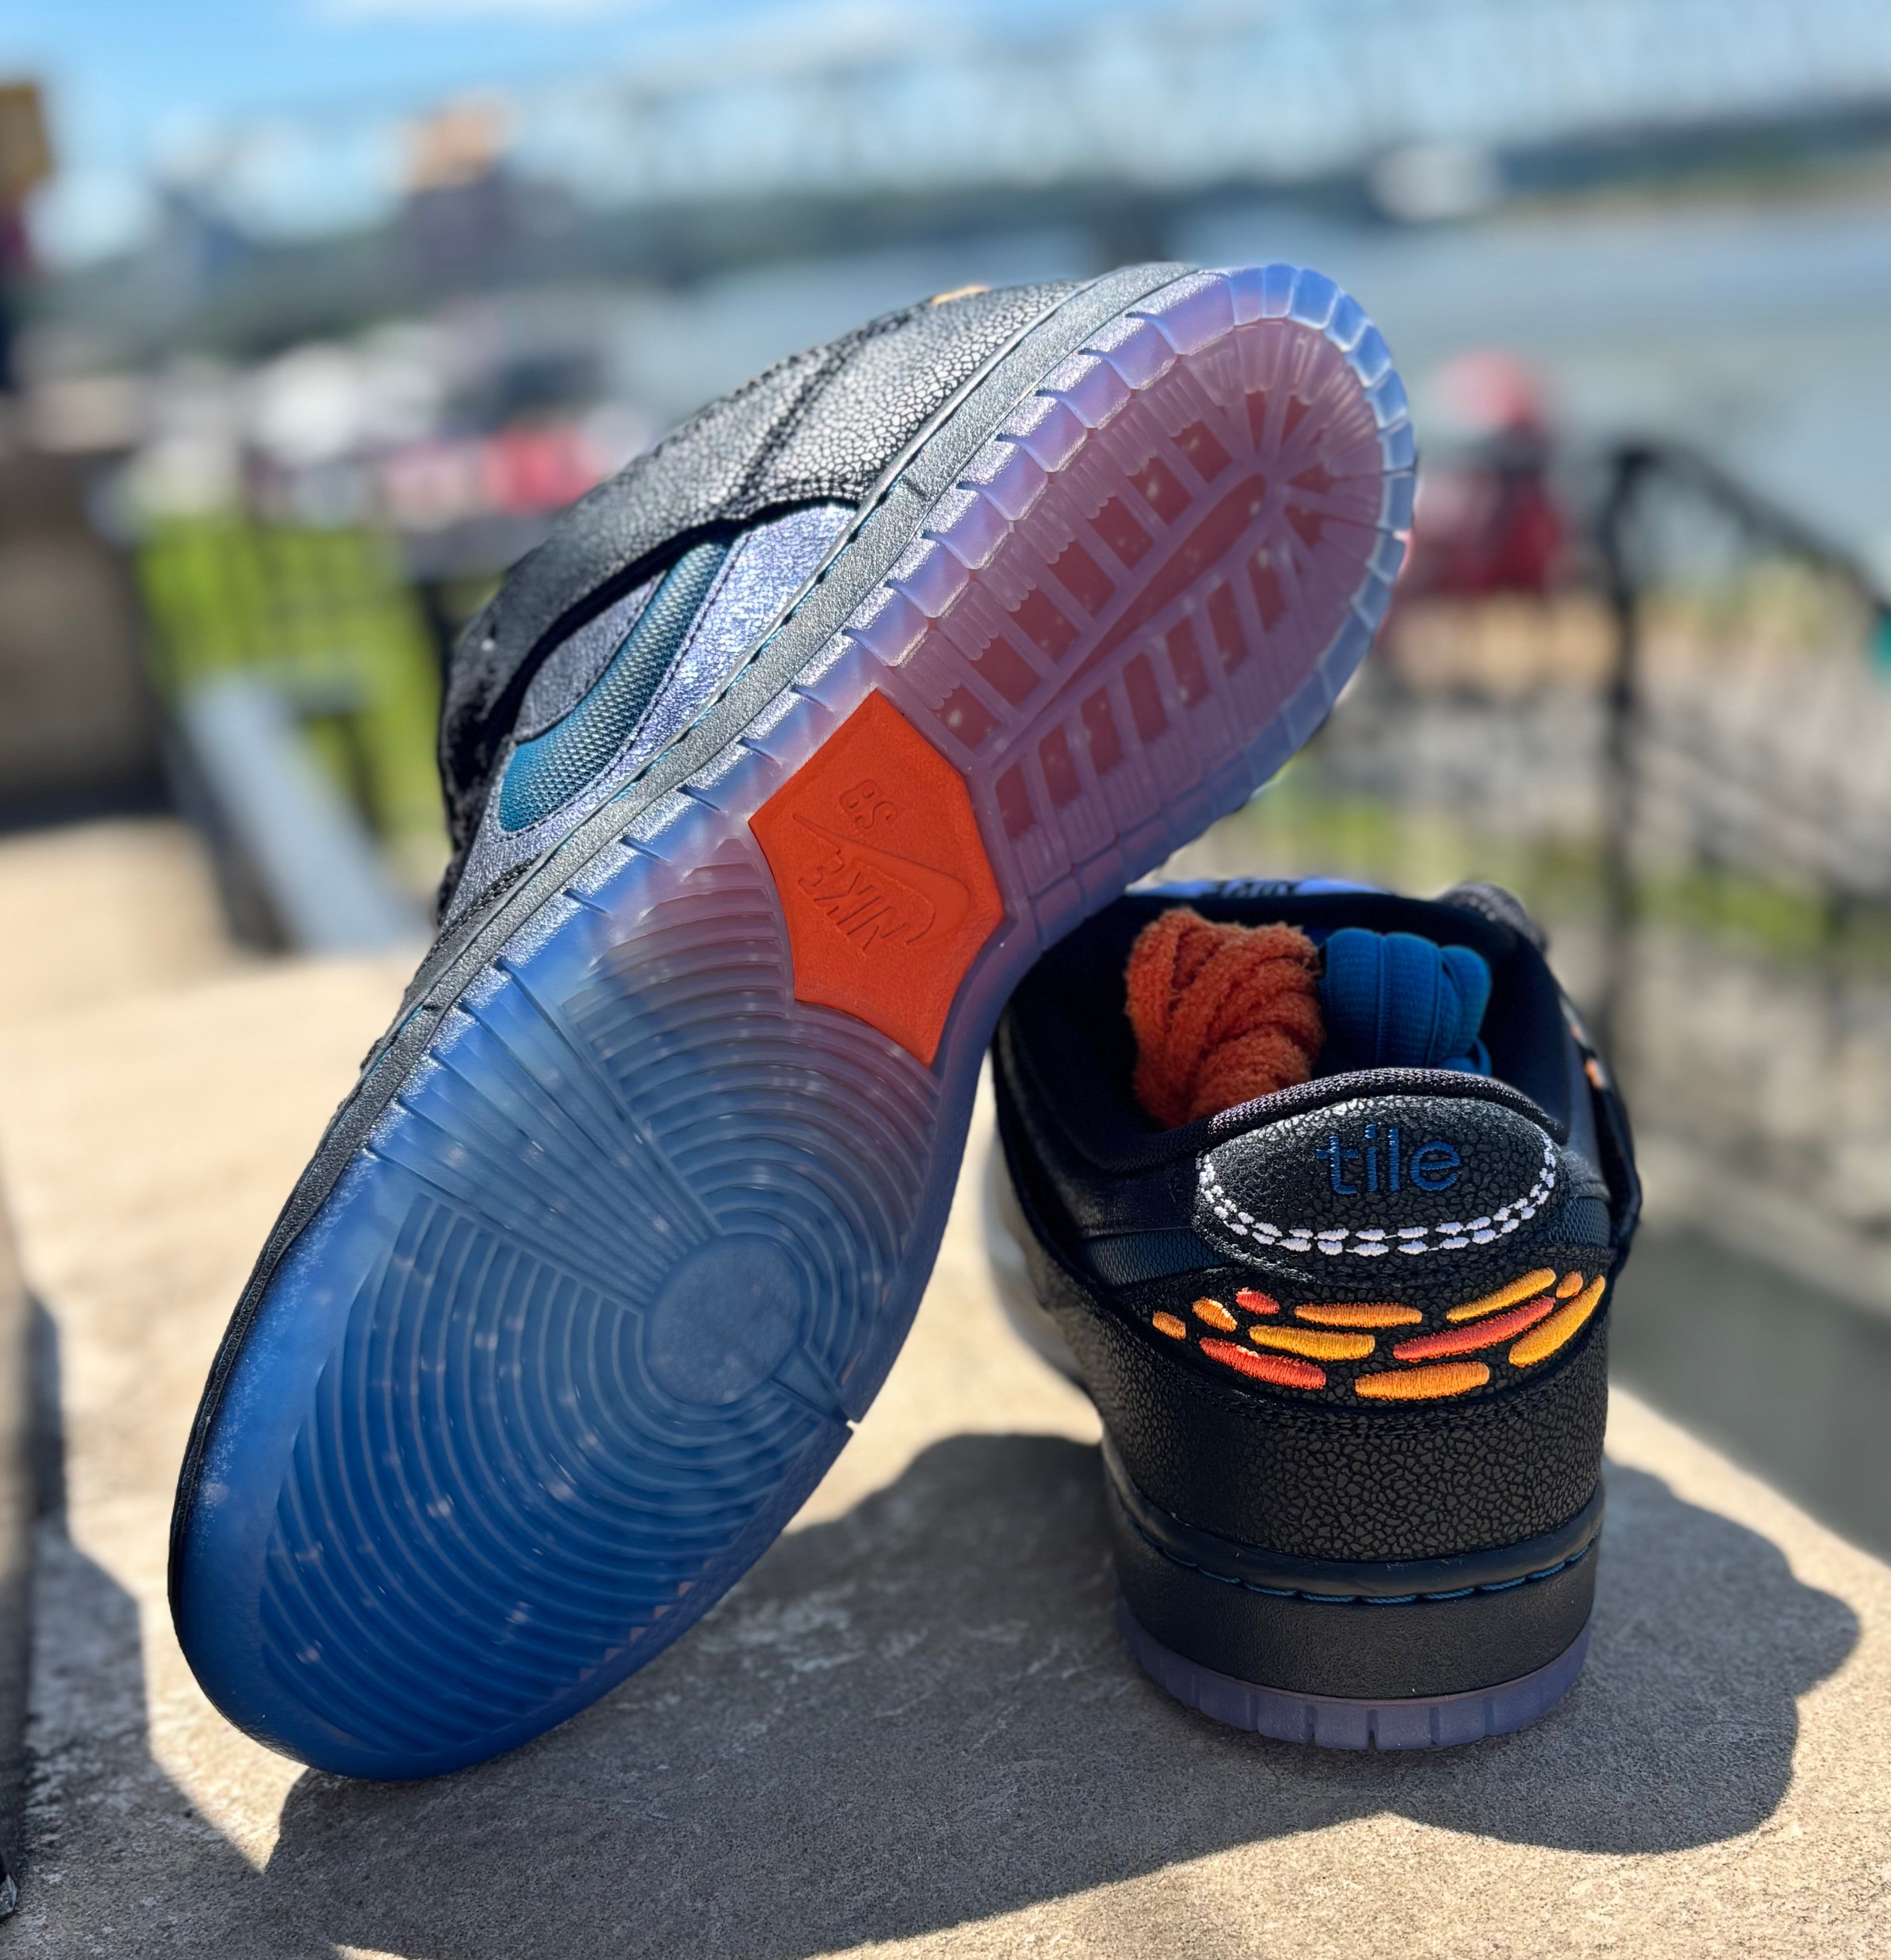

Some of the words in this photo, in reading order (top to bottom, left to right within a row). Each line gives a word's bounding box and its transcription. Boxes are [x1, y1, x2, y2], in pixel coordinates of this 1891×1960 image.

[839, 779, 897, 832] SB
[797, 848, 910, 953] NIKE
[1315, 1124, 1462, 1195] tile
